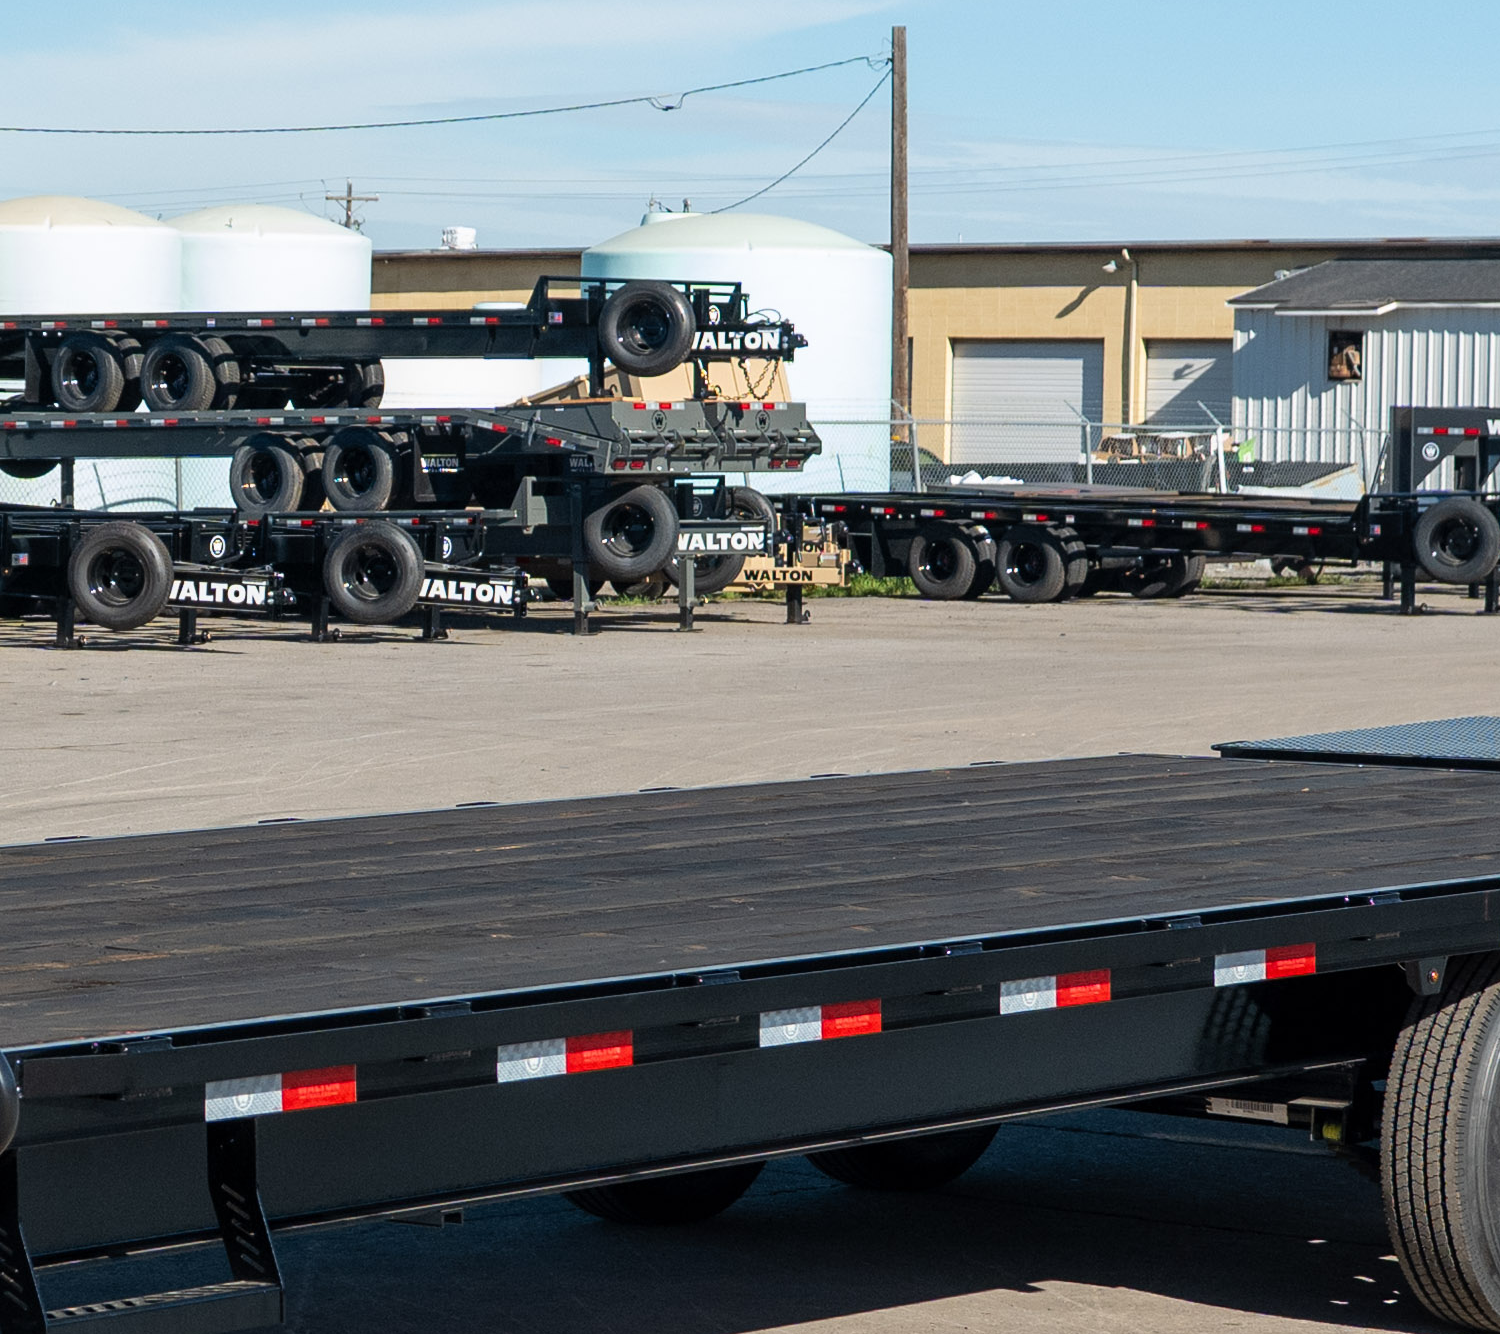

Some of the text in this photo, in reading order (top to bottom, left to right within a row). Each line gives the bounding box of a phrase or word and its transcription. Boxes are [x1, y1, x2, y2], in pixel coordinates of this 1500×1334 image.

[744, 569, 813, 582] WALTON
[169, 579, 266, 605] ALTON
[418, 578, 514, 605] ALTON
